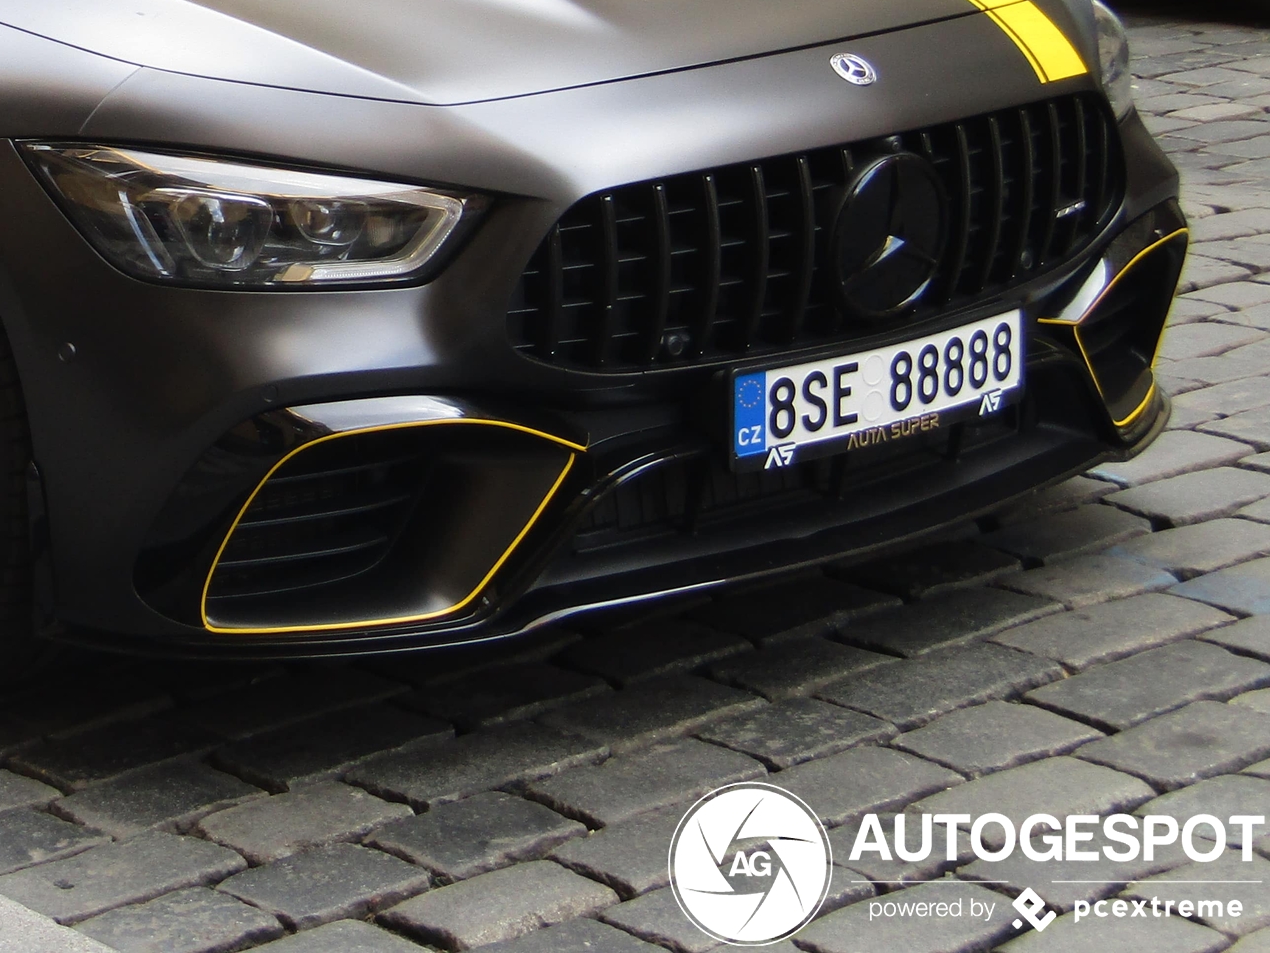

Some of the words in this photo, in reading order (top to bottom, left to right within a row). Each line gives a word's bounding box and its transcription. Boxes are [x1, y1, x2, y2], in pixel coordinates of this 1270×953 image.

[769, 361, 859, 439] 8SE
[889, 321, 1012, 412] 88888
[738, 425, 762, 446] CZ
[847, 427, 888, 450] AUTA
[891, 412, 940, 440] SUPER
